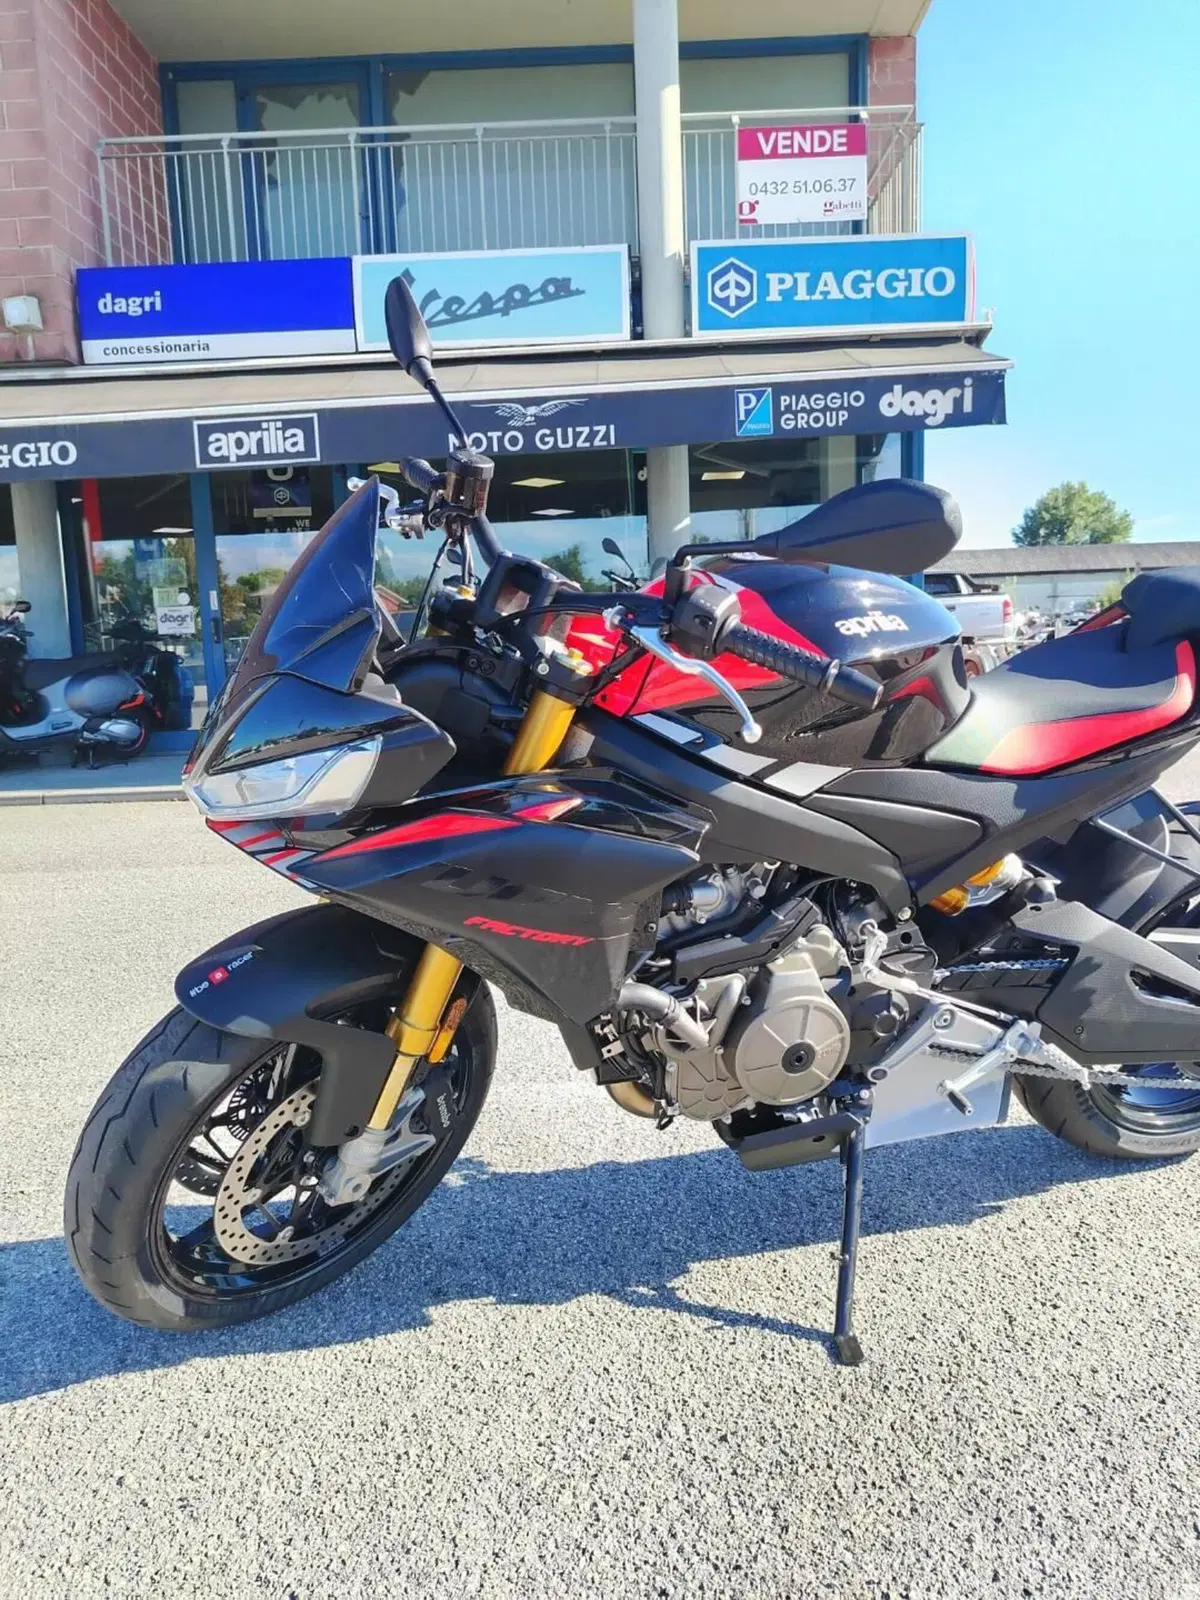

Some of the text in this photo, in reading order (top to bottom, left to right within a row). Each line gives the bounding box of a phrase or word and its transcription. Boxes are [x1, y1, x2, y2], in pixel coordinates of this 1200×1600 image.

[757, 129, 848, 155] VENDE
[749, 178, 857, 196] 0432 51.06.37
[822, 200, 862, 216] gabetti
[765, 266, 956, 302] PIAGGIO
[98, 291, 162, 316] dagri
[103, 341, 210, 356] concessionaria
[780, 391, 865, 411] PIAGGIO
[879, 377, 973, 426] dagri
[780, 410, 849, 429] GROUP
[207, 421, 305, 462] aprilia
[535, 424, 616, 450] GUZZI
[160, 611, 194, 626] dagri
[834, 610, 909, 638] aprilia
[464, 916, 595, 946] FACTORY
[189, 981, 209, 998] #be
[227, 951, 253, 971] racer
[437, 1092, 451, 1128] brembo
